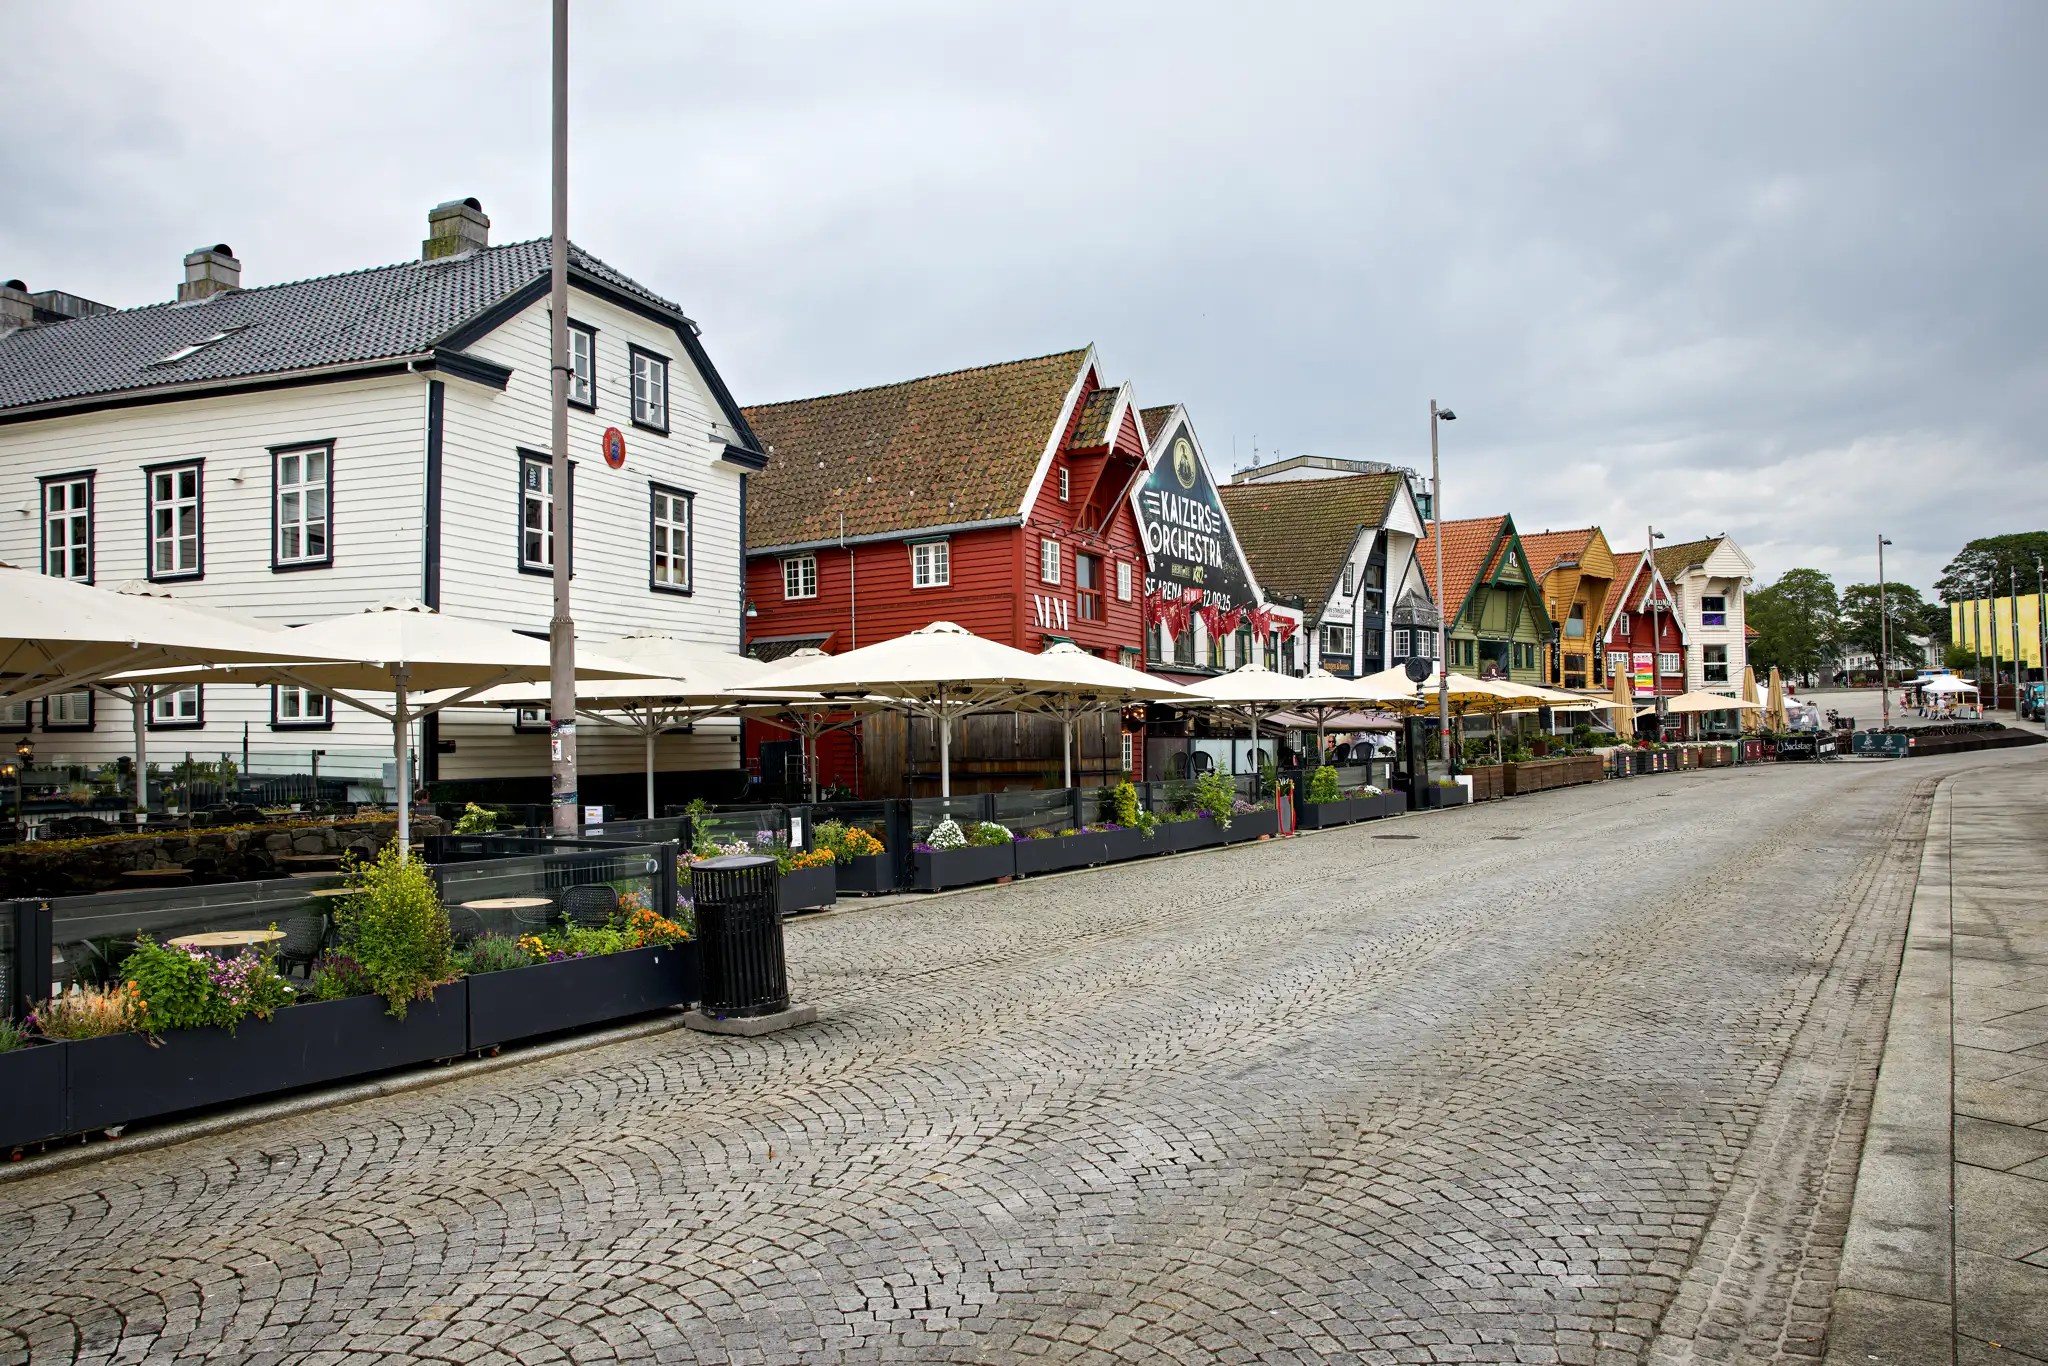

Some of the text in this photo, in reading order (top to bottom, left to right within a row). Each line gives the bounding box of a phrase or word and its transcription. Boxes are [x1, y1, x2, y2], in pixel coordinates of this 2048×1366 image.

[1161, 491, 1212, 534] KAIZERS
[1148, 522, 1223, 569] ORCHESTRA
[1157, 580, 1182, 600] ARENA
[1203, 590, 1231, 611] 12.09.25
